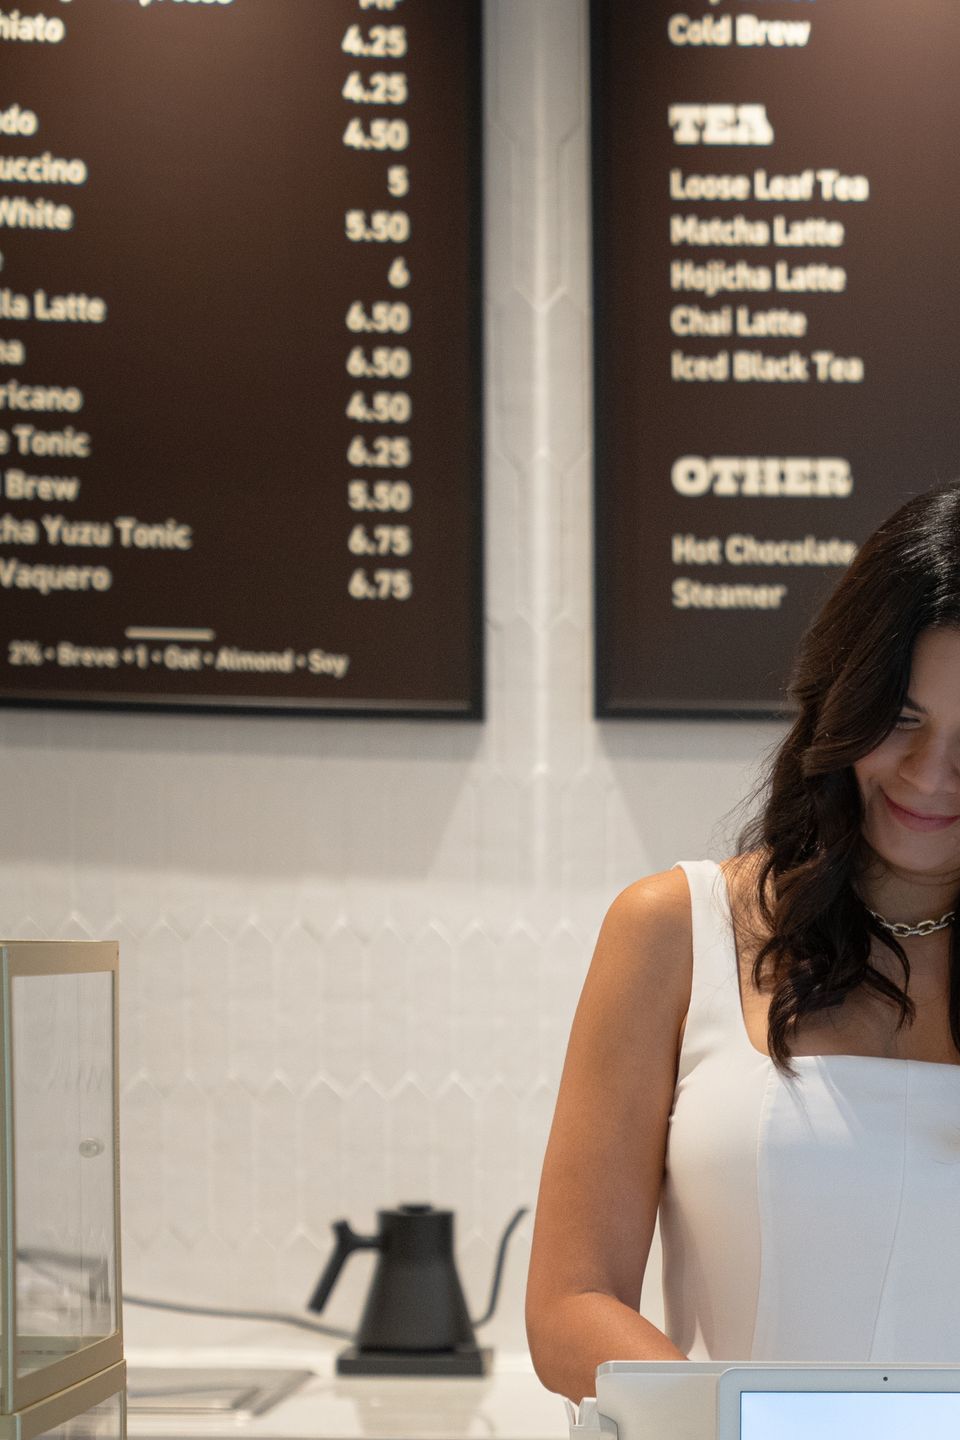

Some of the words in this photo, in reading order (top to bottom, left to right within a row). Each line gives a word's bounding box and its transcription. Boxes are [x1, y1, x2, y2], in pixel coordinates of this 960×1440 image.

[342, 26, 406, 56] 4.25
[669, 15, 732, 45] Cold
[736, 15, 811, 46] Brew
[343, 72, 406, 103] 4.25
[0, 105, 37, 135] do
[343, 119, 407, 149] 4.50
[669, 104, 774, 145] TEA
[388, 167, 408, 196] 5
[671, 171, 750, 200] Loose
[755, 171, 814, 200] Leaf
[816, 170, 869, 201] Tea
[346, 211, 409, 241] 5.50
[671, 217, 769, 245] Matcha
[774, 217, 844, 246] Latte
[389, 259, 408, 287] 6
[671, 262, 771, 295] Hojicha
[776, 263, 846, 291] Latte
[35, 292, 105, 322] Latte
[346, 303, 409, 332] 6.50
[671, 306, 732, 335] Chai
[737, 308, 806, 336] Latte
[347, 348, 410, 377] 6.50
[672, 353, 728, 380] Iced
[734, 352, 808, 380] Black
[812, 352, 863, 381] Tea
[347, 393, 410, 422] 4.50
[13, 426, 88, 456] Tonic
[348, 438, 410, 466] 6.25
[6, 470, 78, 500] Brew
[672, 457, 852, 496] OTHER
[349, 481, 410, 510] 5.50
[0, 516, 37, 543] ha
[43, 516, 111, 546] Yuzu
[116, 518, 190, 548] Tonic
[349, 526, 410, 555] 6.75
[673, 537, 720, 563] Hot
[726, 536, 857, 564] Chocolate
[349, 570, 410, 599] 6.75
[673, 580, 785, 608] Steamer
[10, 642, 42, 664] 2%
[164, 646, 200, 669] Oat
[216, 648, 294, 672] Almond
[308, 643, 348, 678] Soy
